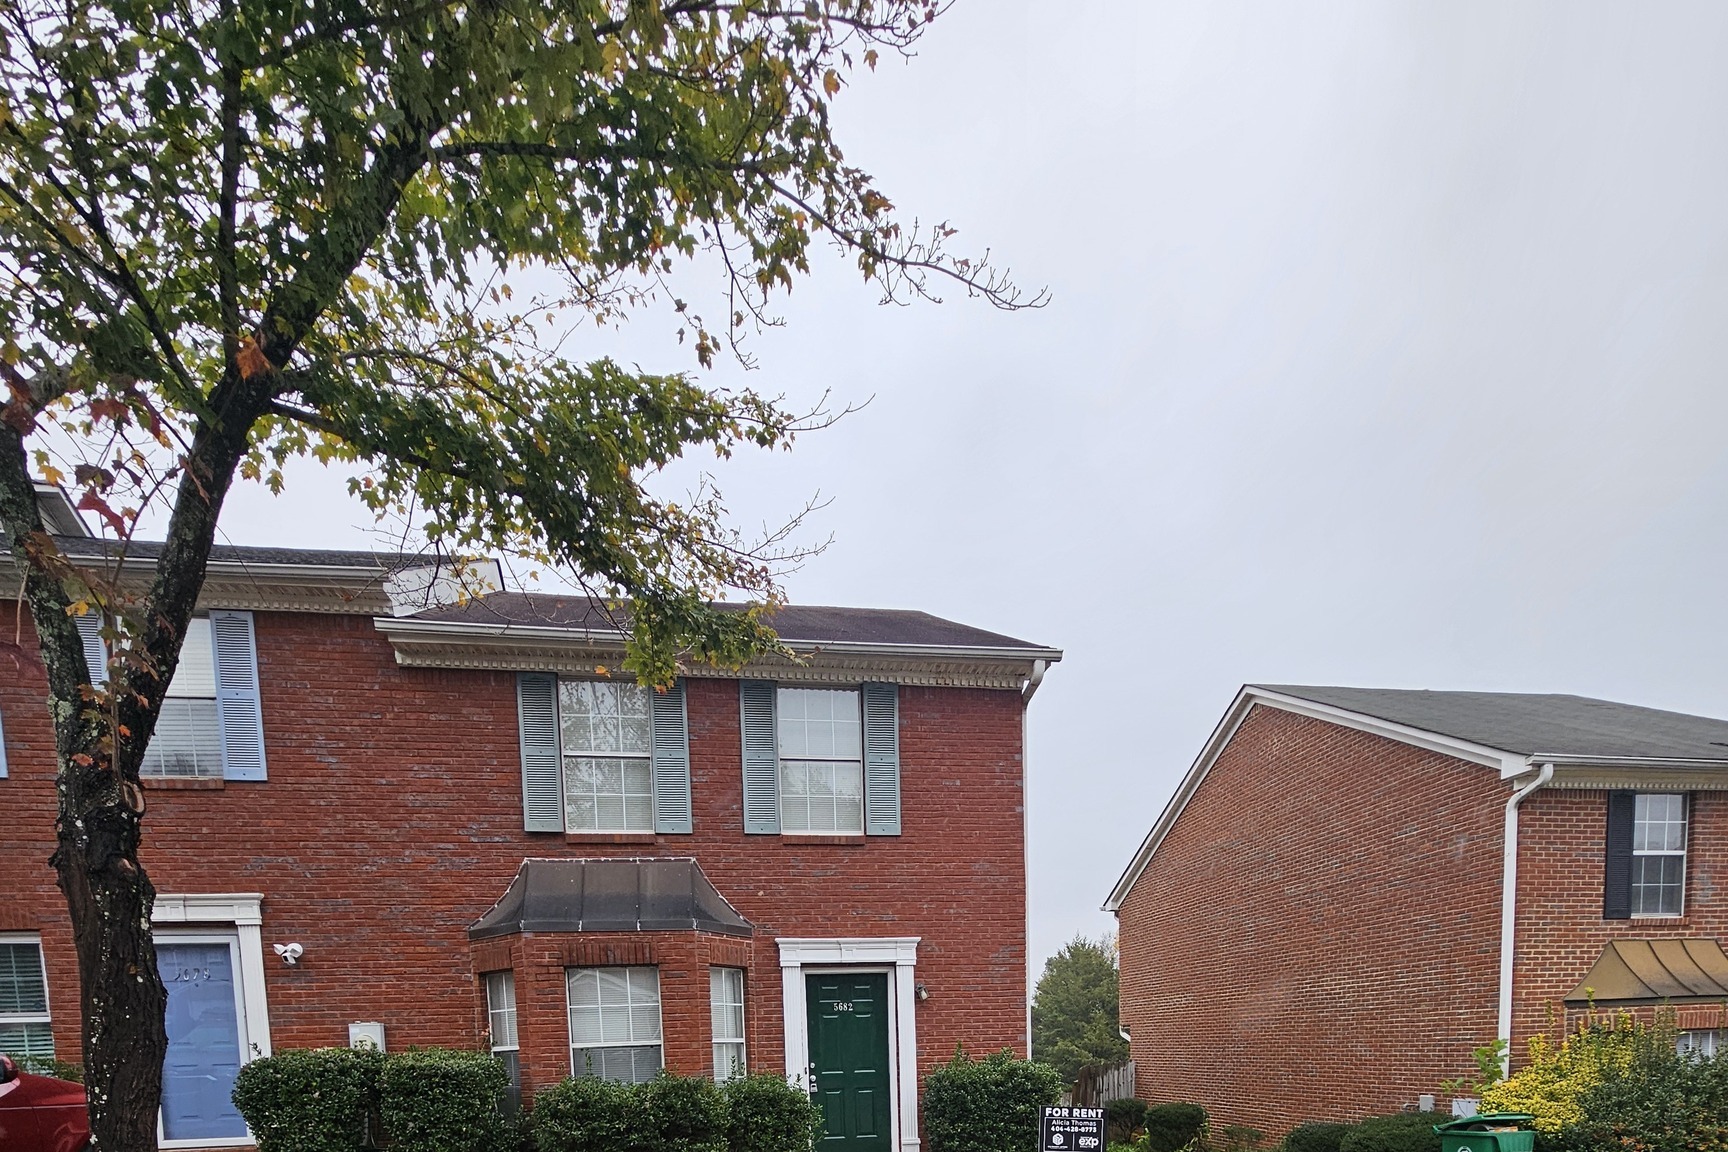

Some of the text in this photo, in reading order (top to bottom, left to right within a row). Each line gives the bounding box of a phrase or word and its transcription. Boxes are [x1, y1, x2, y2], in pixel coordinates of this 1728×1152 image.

[833, 1002, 854, 1012] 5682
[1045, 1107, 1104, 1119] FOR RENT
[1071, 1119, 1097, 1127] Thomas
